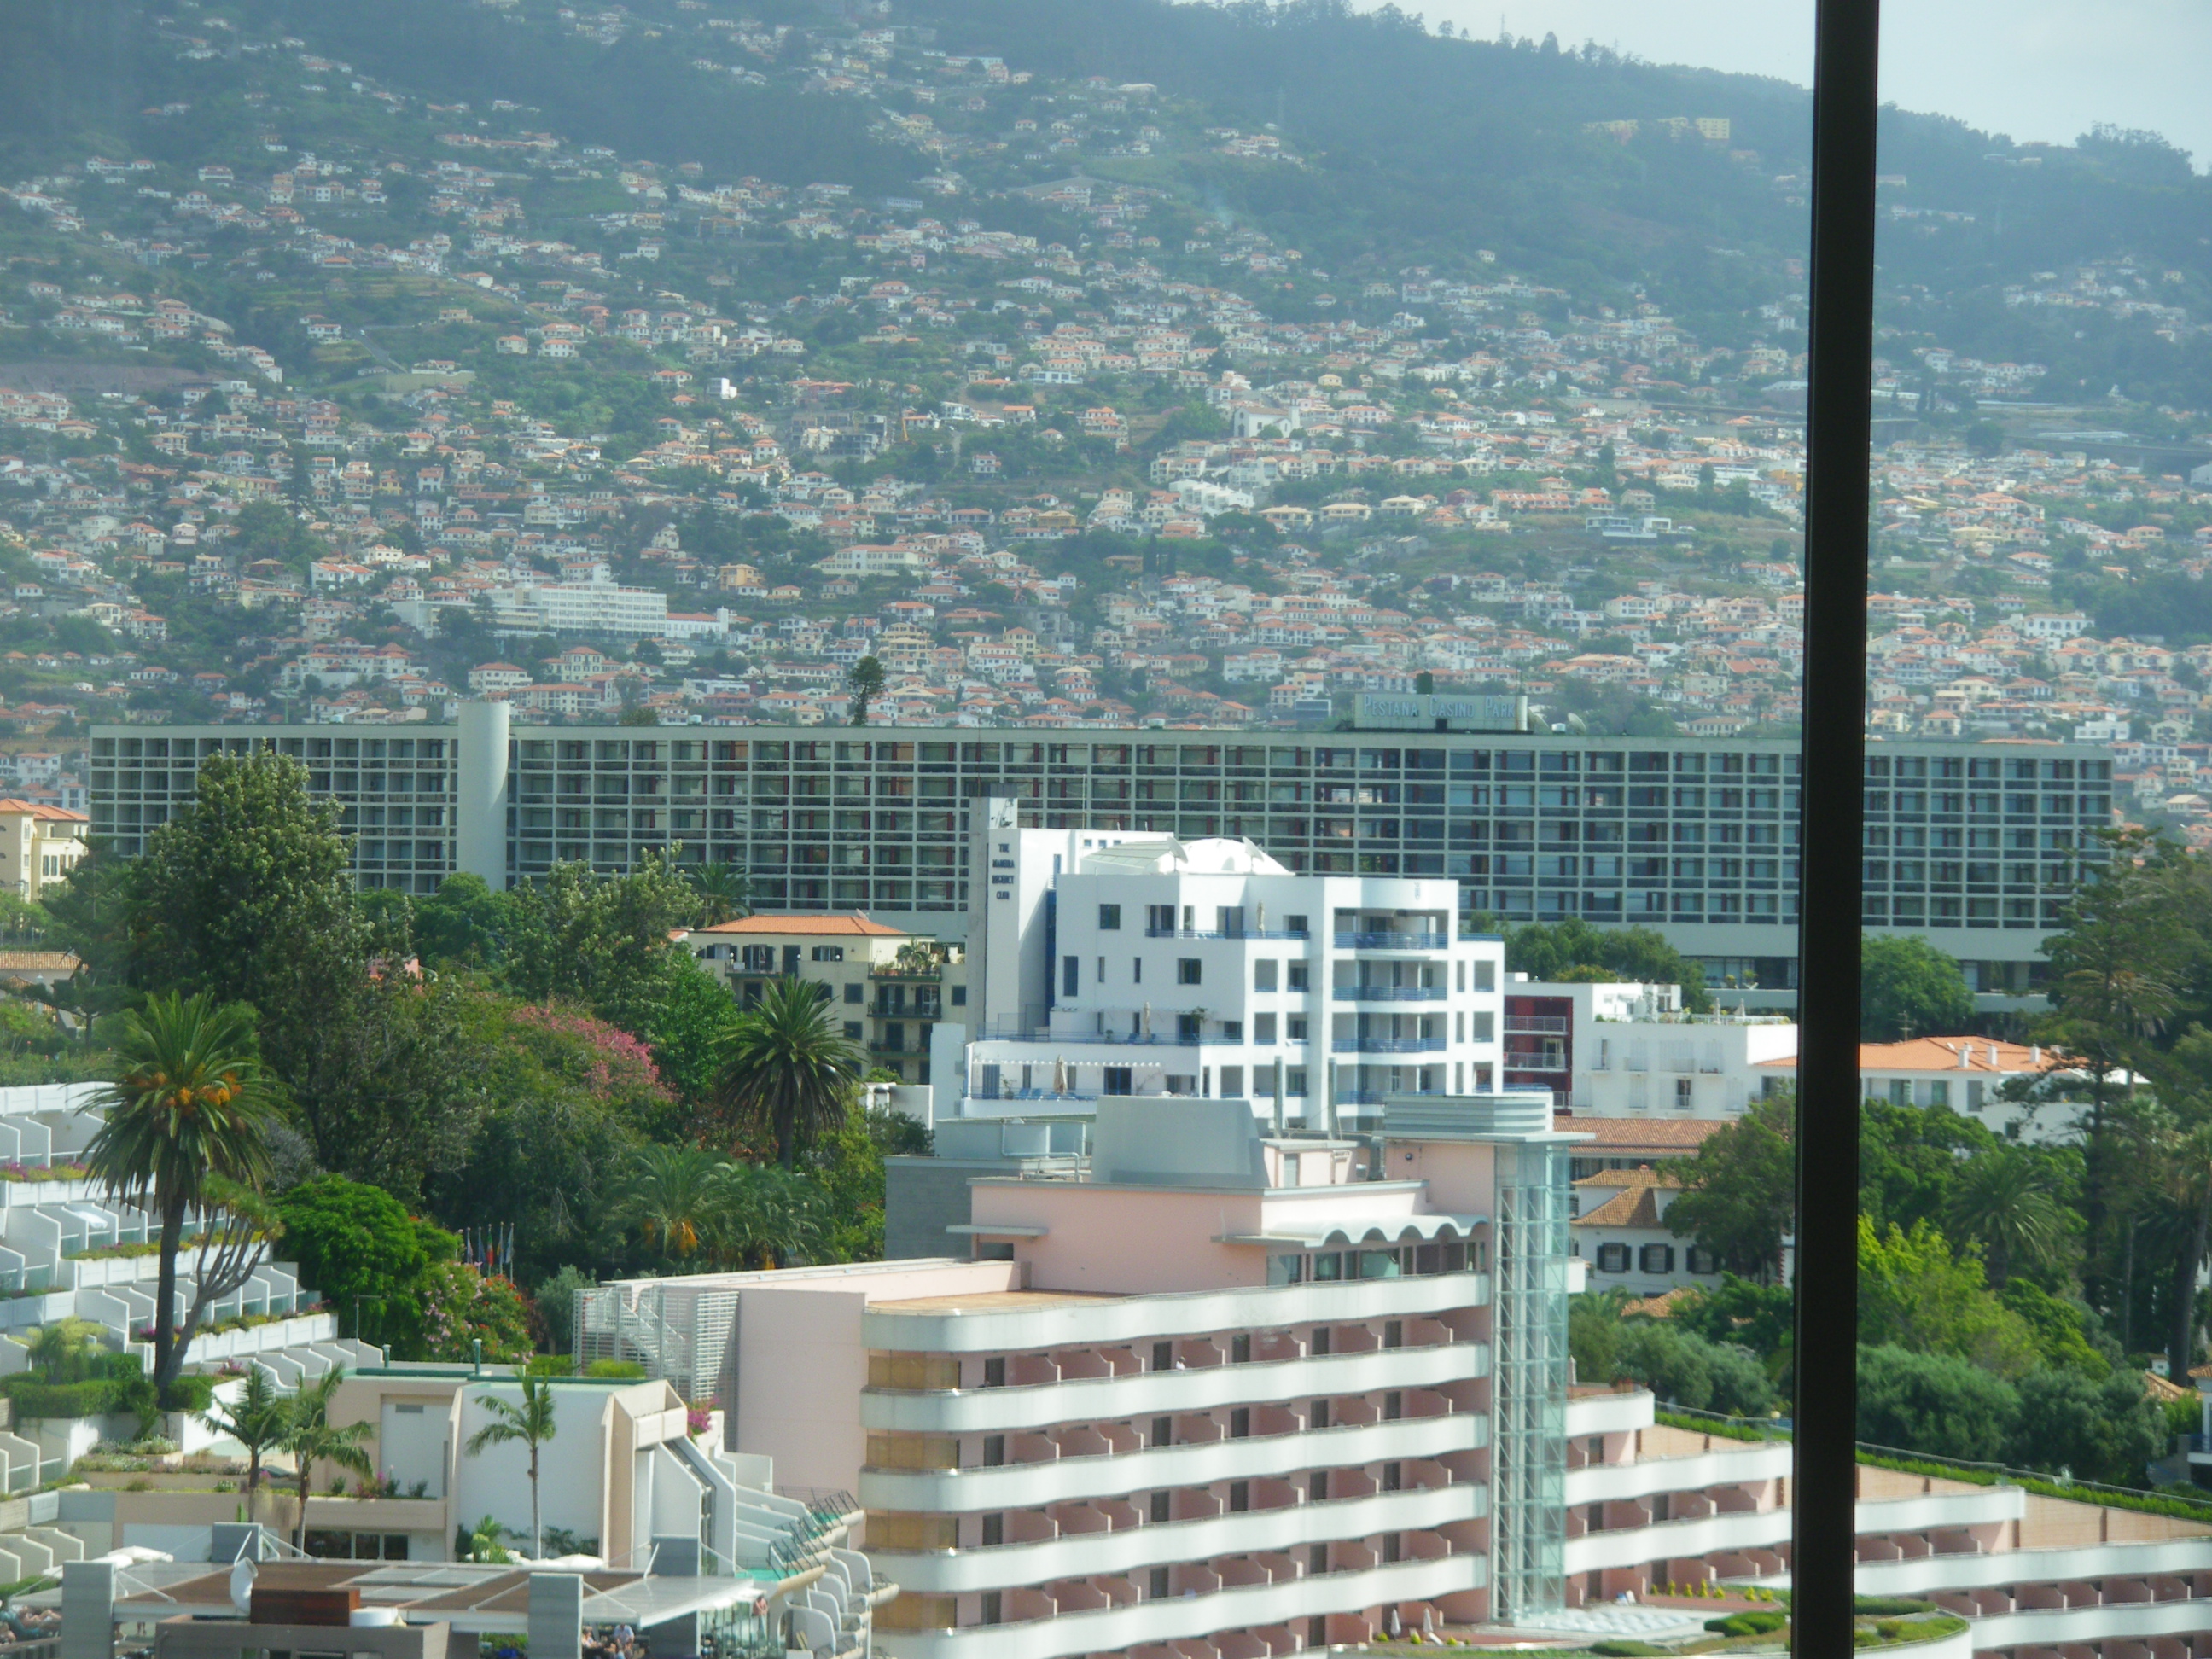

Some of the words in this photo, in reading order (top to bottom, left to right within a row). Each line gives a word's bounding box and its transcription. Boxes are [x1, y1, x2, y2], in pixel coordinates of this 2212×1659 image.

[1364, 696, 1417, 718] PESTANA
[1429, 696, 1475, 718] CASINO
[1485, 696, 1516, 718] PARK
